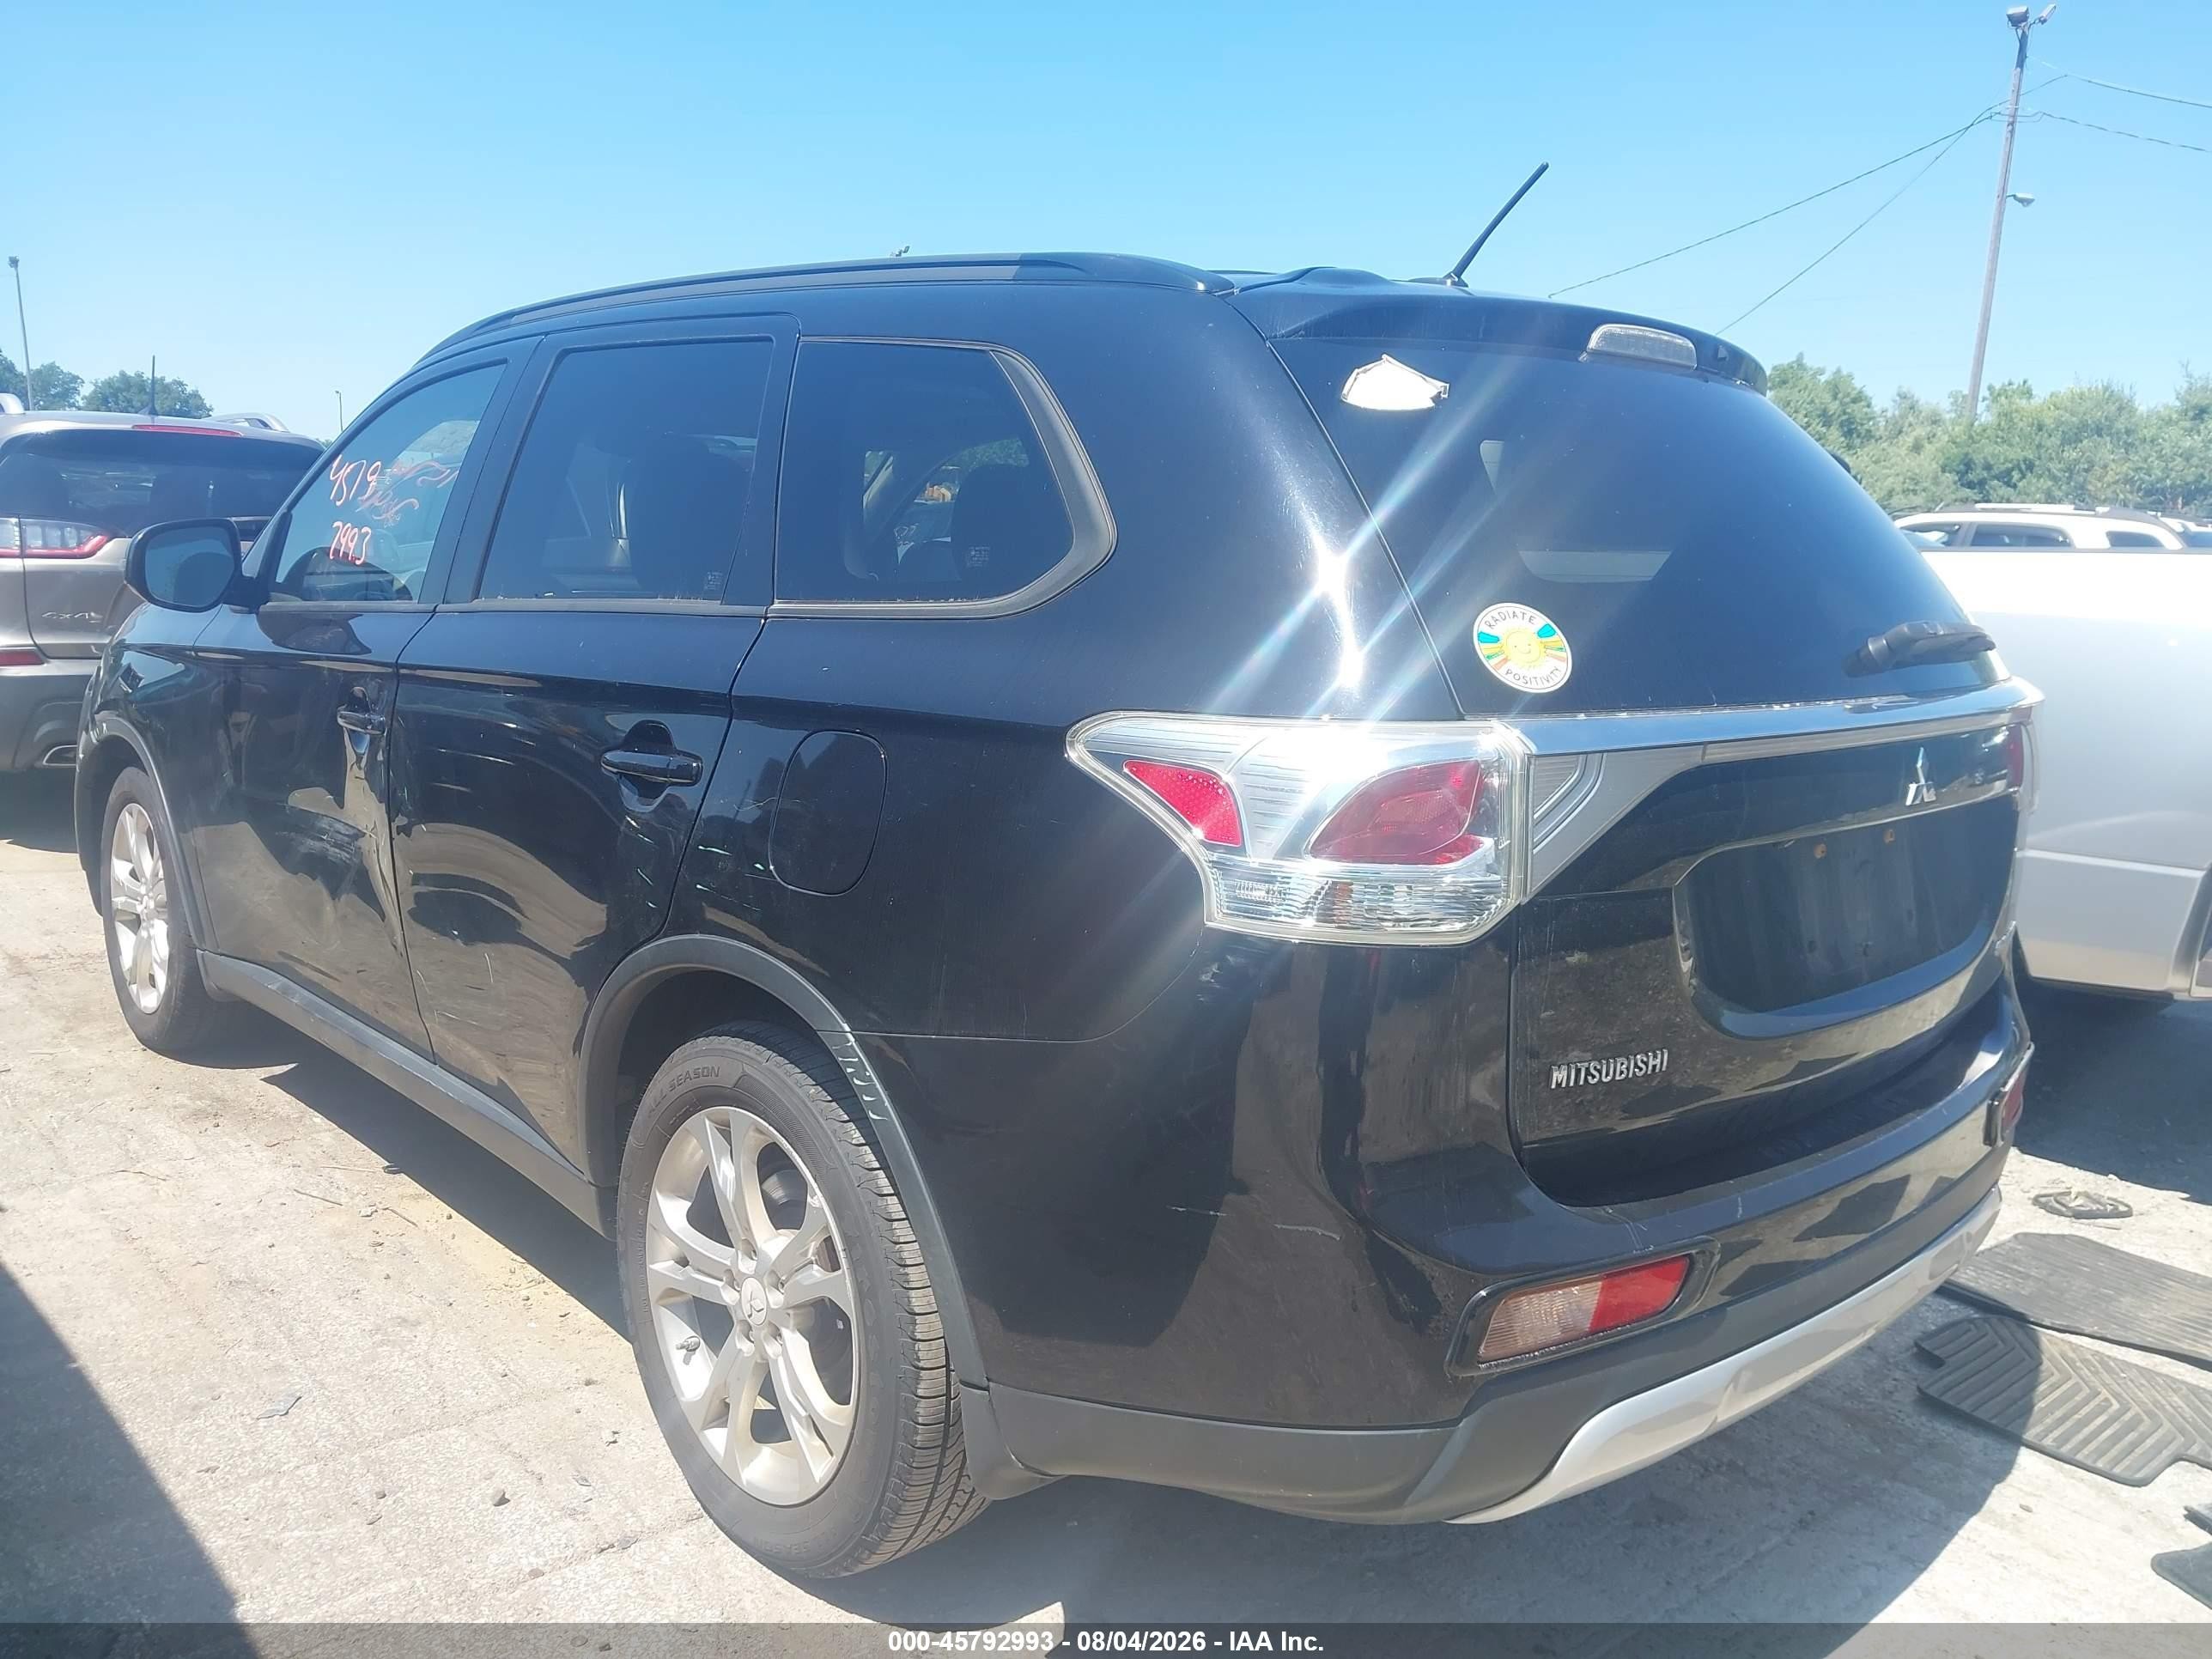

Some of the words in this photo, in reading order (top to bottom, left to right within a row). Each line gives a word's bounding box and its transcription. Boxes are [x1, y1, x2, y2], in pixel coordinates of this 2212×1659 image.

[1485, 611, 1536, 629] RADIATE
[1505, 665, 1562, 687] POSITIVITY
[669, 1066, 720, 1092] SEASON
[1550, 1048, 1668, 1089] MITSUBISHI
